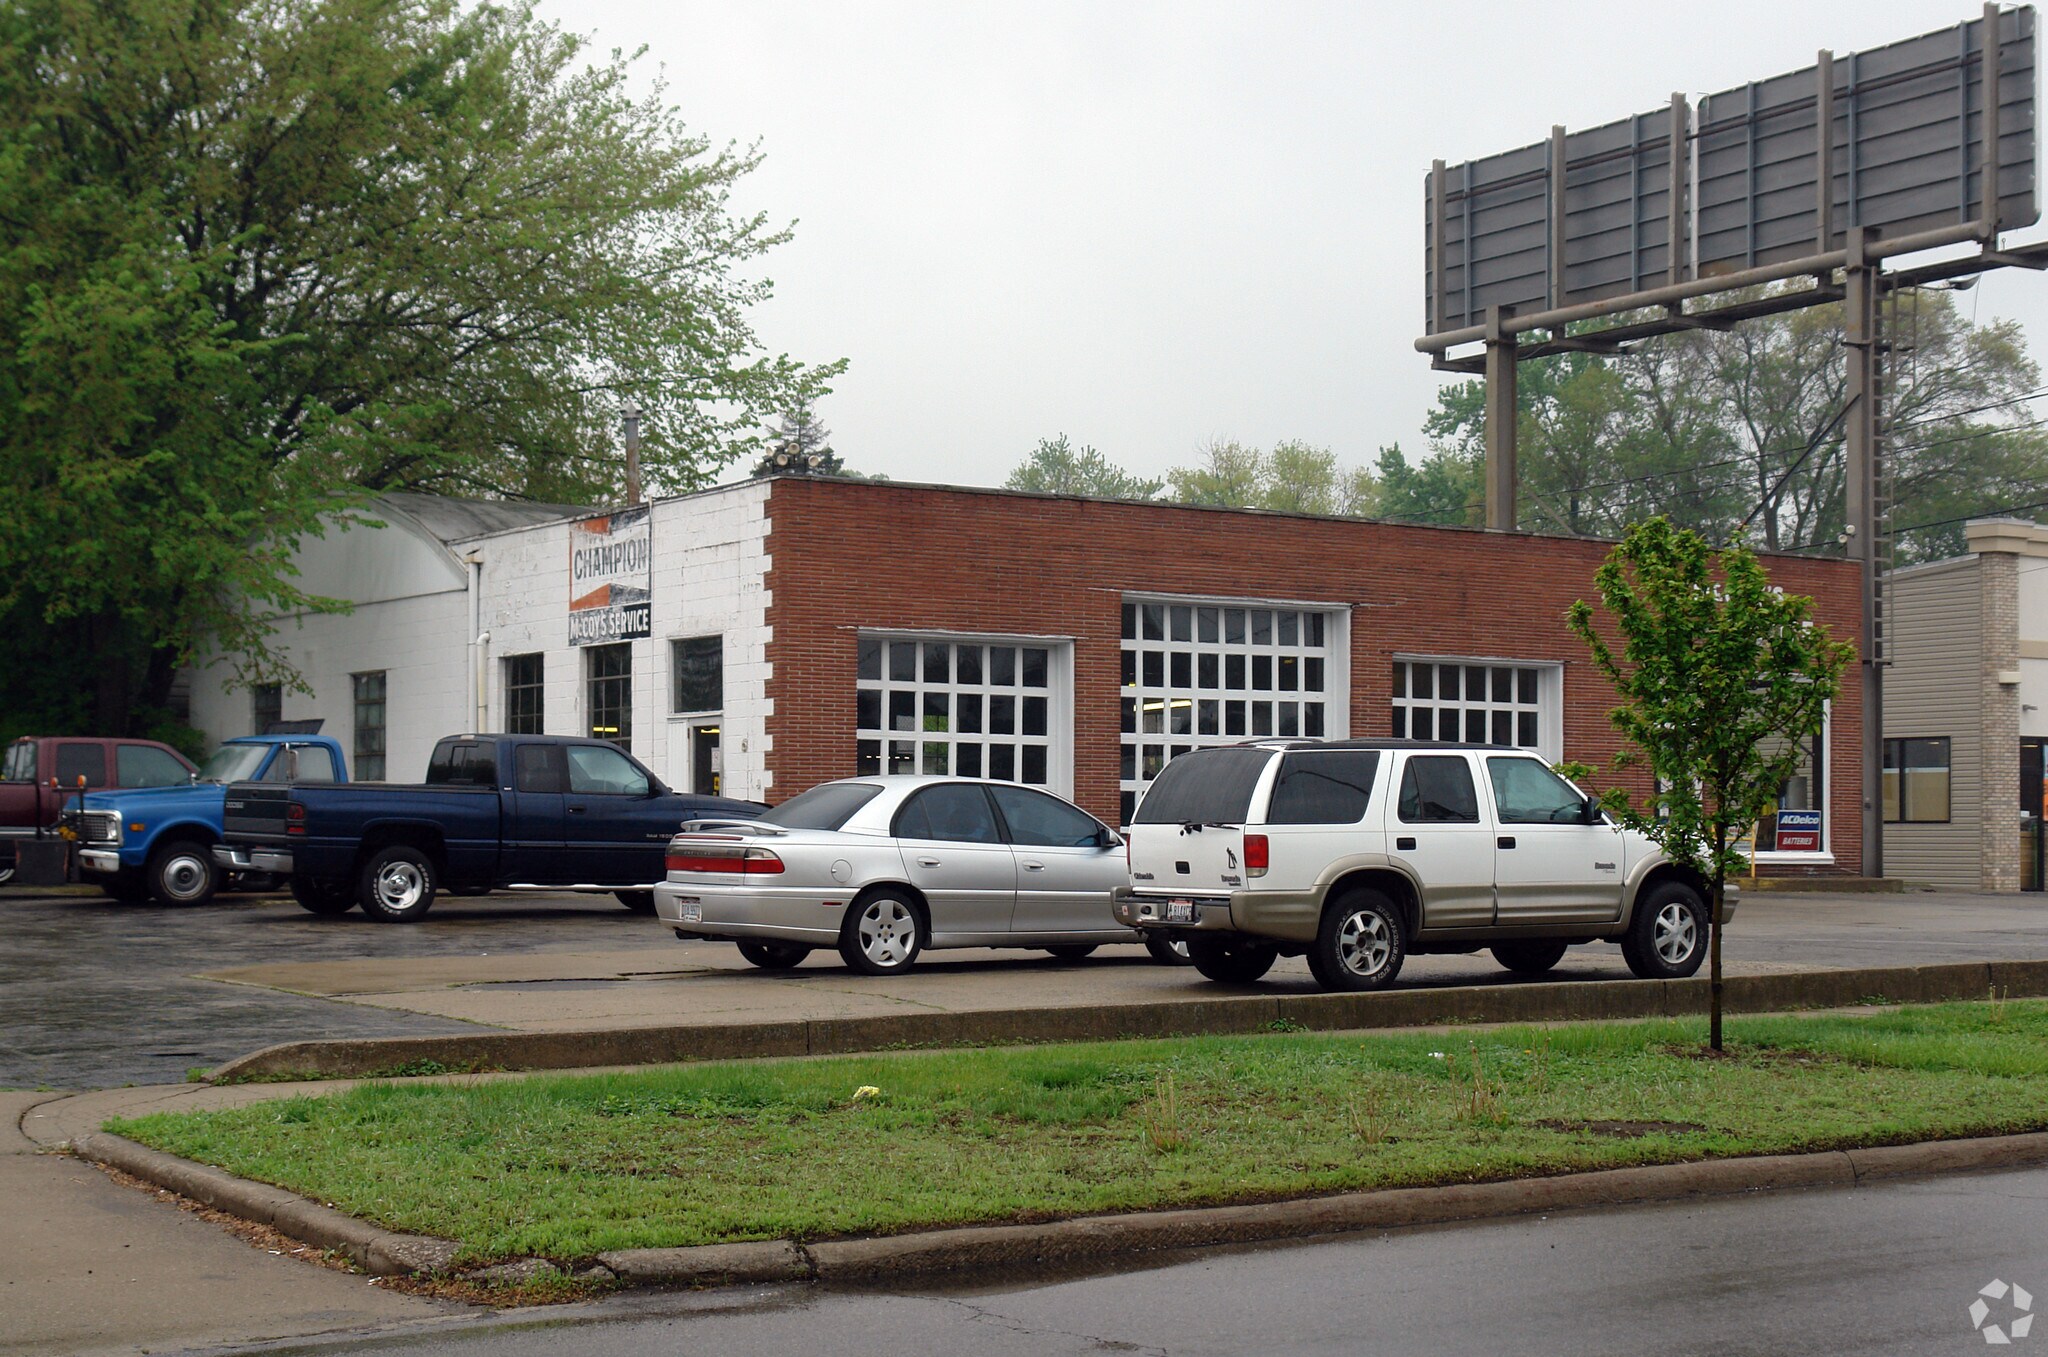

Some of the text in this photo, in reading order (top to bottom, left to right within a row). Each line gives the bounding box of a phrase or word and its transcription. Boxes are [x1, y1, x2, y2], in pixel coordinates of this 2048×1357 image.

[574, 538, 647, 580] CHAMPION
[609, 609, 648, 635] SERVICE
[1780, 815, 1819, 824] ACDelco
[1782, 837, 1813, 845] BATTERIES
